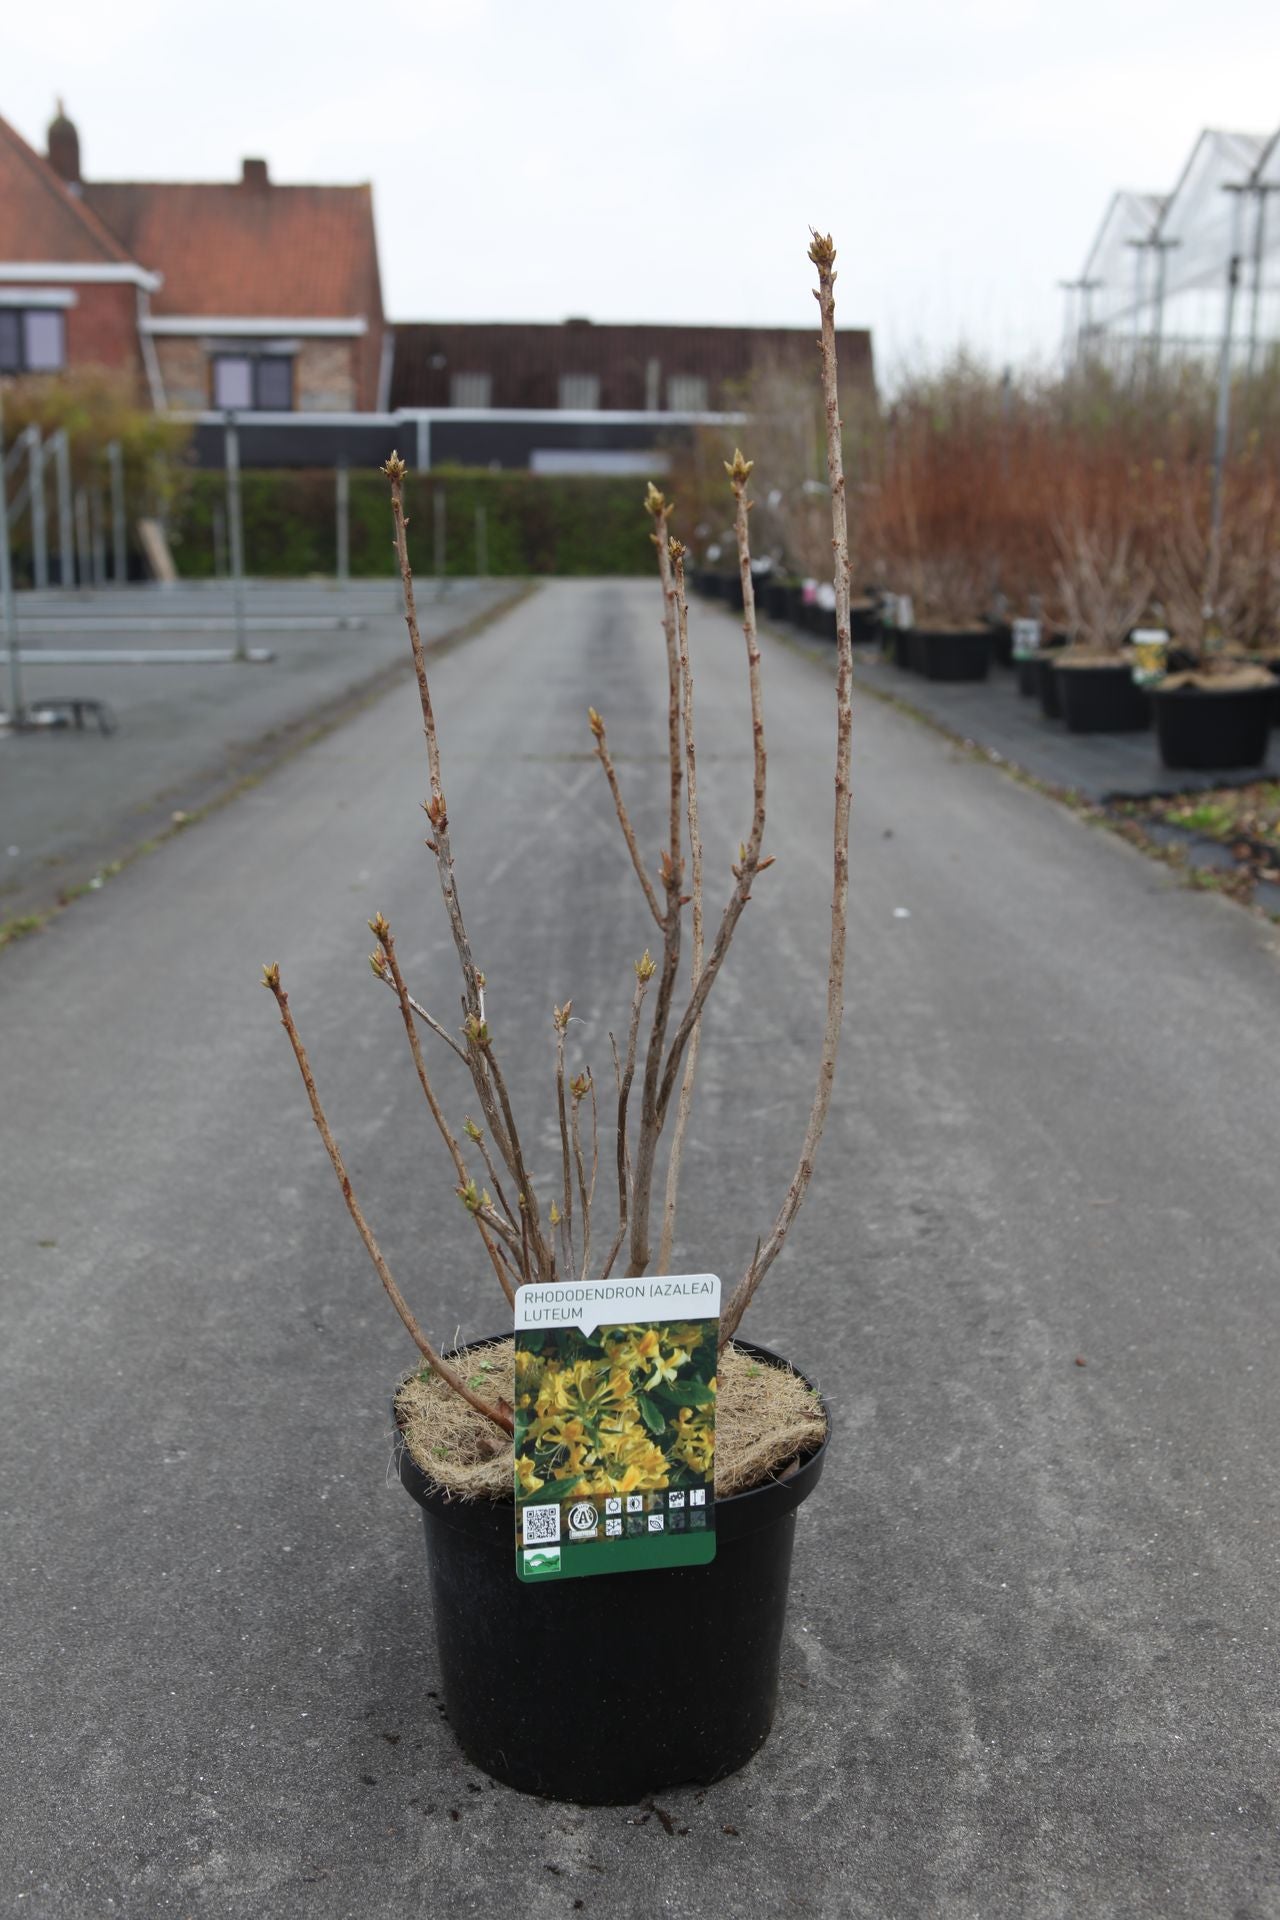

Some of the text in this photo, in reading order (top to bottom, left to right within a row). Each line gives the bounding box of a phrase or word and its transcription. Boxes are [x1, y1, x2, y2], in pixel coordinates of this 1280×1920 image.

[524, 1281, 714, 1304] RHODODENDRON (AZALEA)
[524, 1307, 583, 1322] LUTEUM
